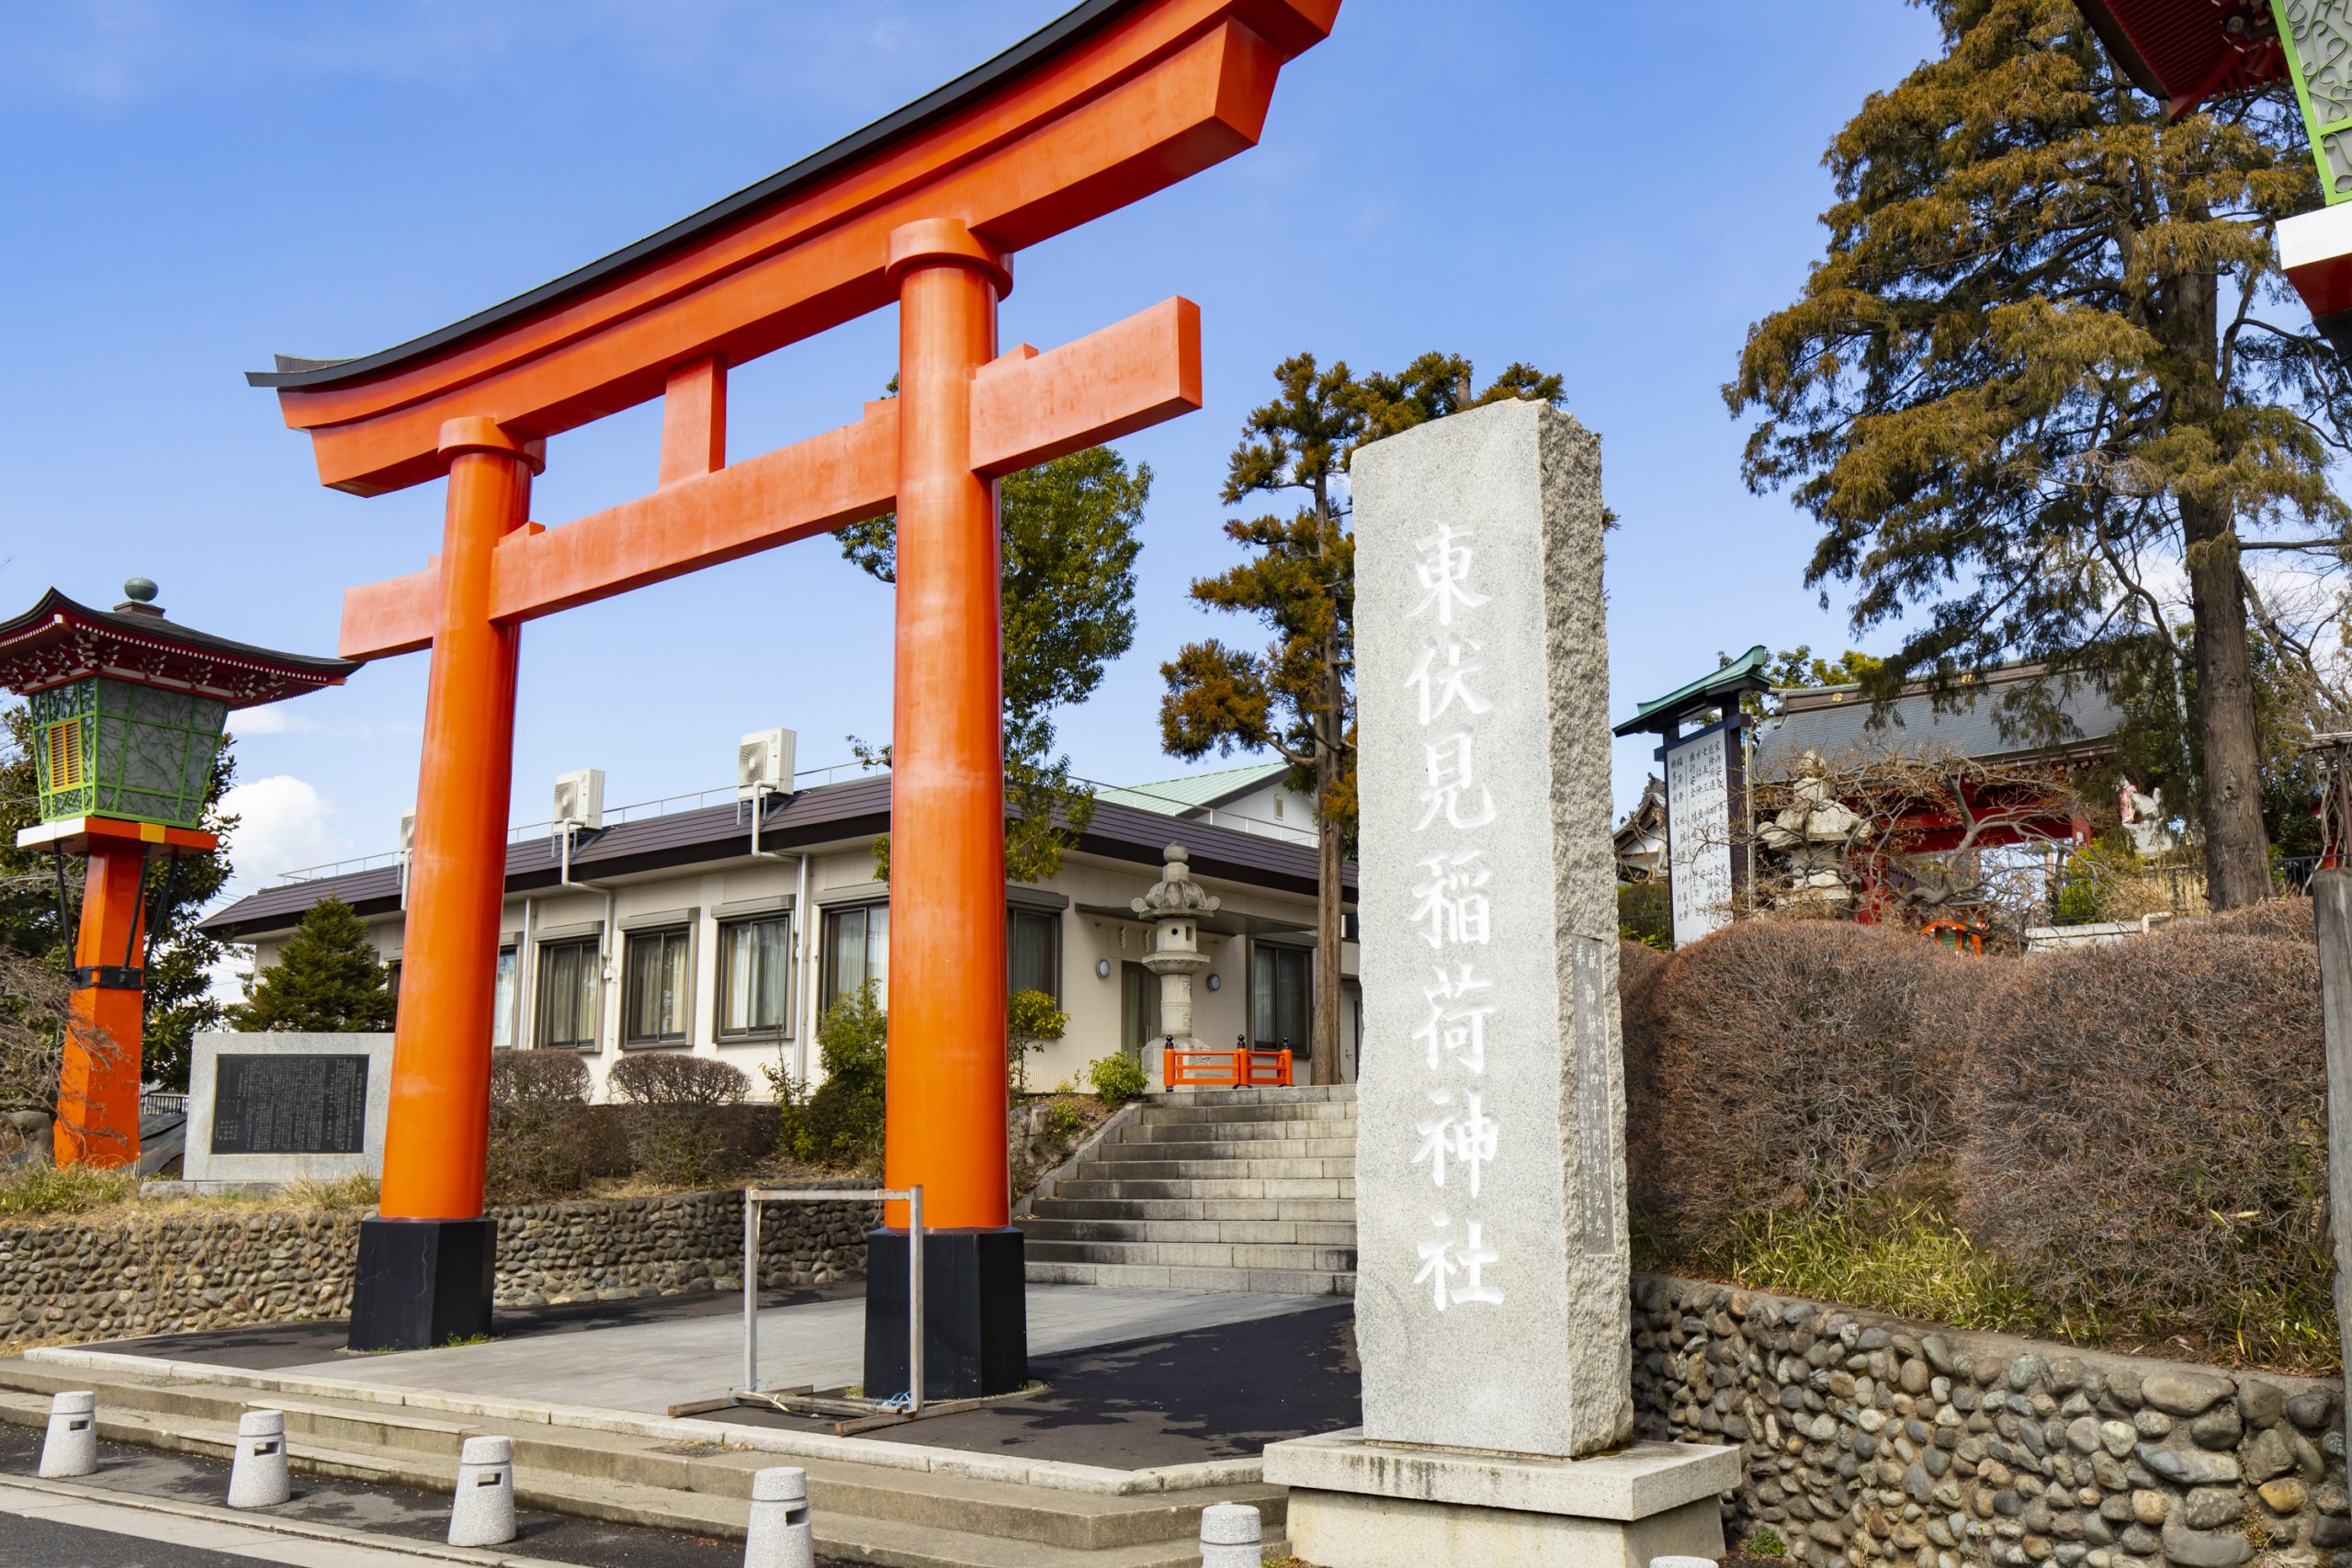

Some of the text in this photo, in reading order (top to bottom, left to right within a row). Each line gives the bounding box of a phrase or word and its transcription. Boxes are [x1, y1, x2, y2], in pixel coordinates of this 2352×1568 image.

[1404, 515, 1504, 1311] 東伏見稲荷神社
